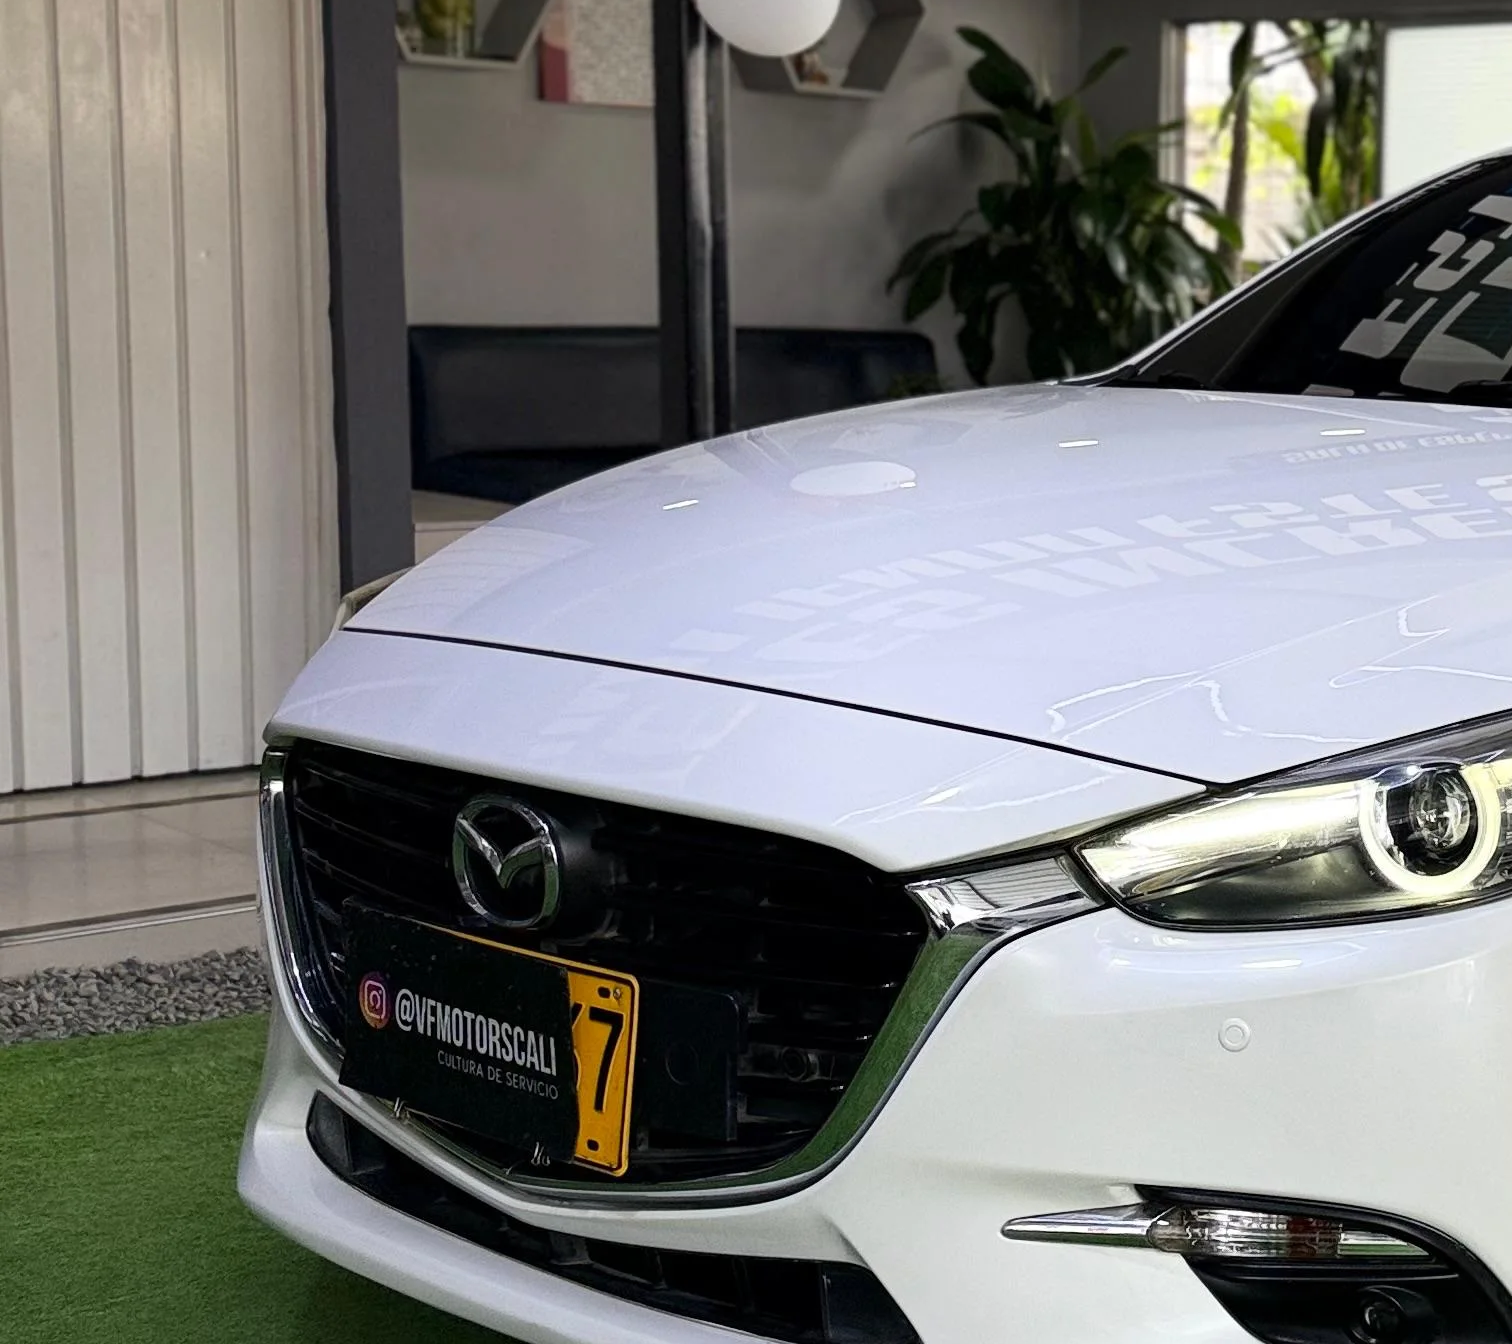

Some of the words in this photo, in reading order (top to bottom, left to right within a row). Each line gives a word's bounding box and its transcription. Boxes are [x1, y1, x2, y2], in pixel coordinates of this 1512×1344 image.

[394, 988, 557, 1077] @VFMOTORSCALI
[437, 1049, 485, 1079] CULTURA
[487, 1065, 504, 1084] DE
[505, 1071, 559, 1100] SERVICIO
[571, 1001, 625, 1115] 7
